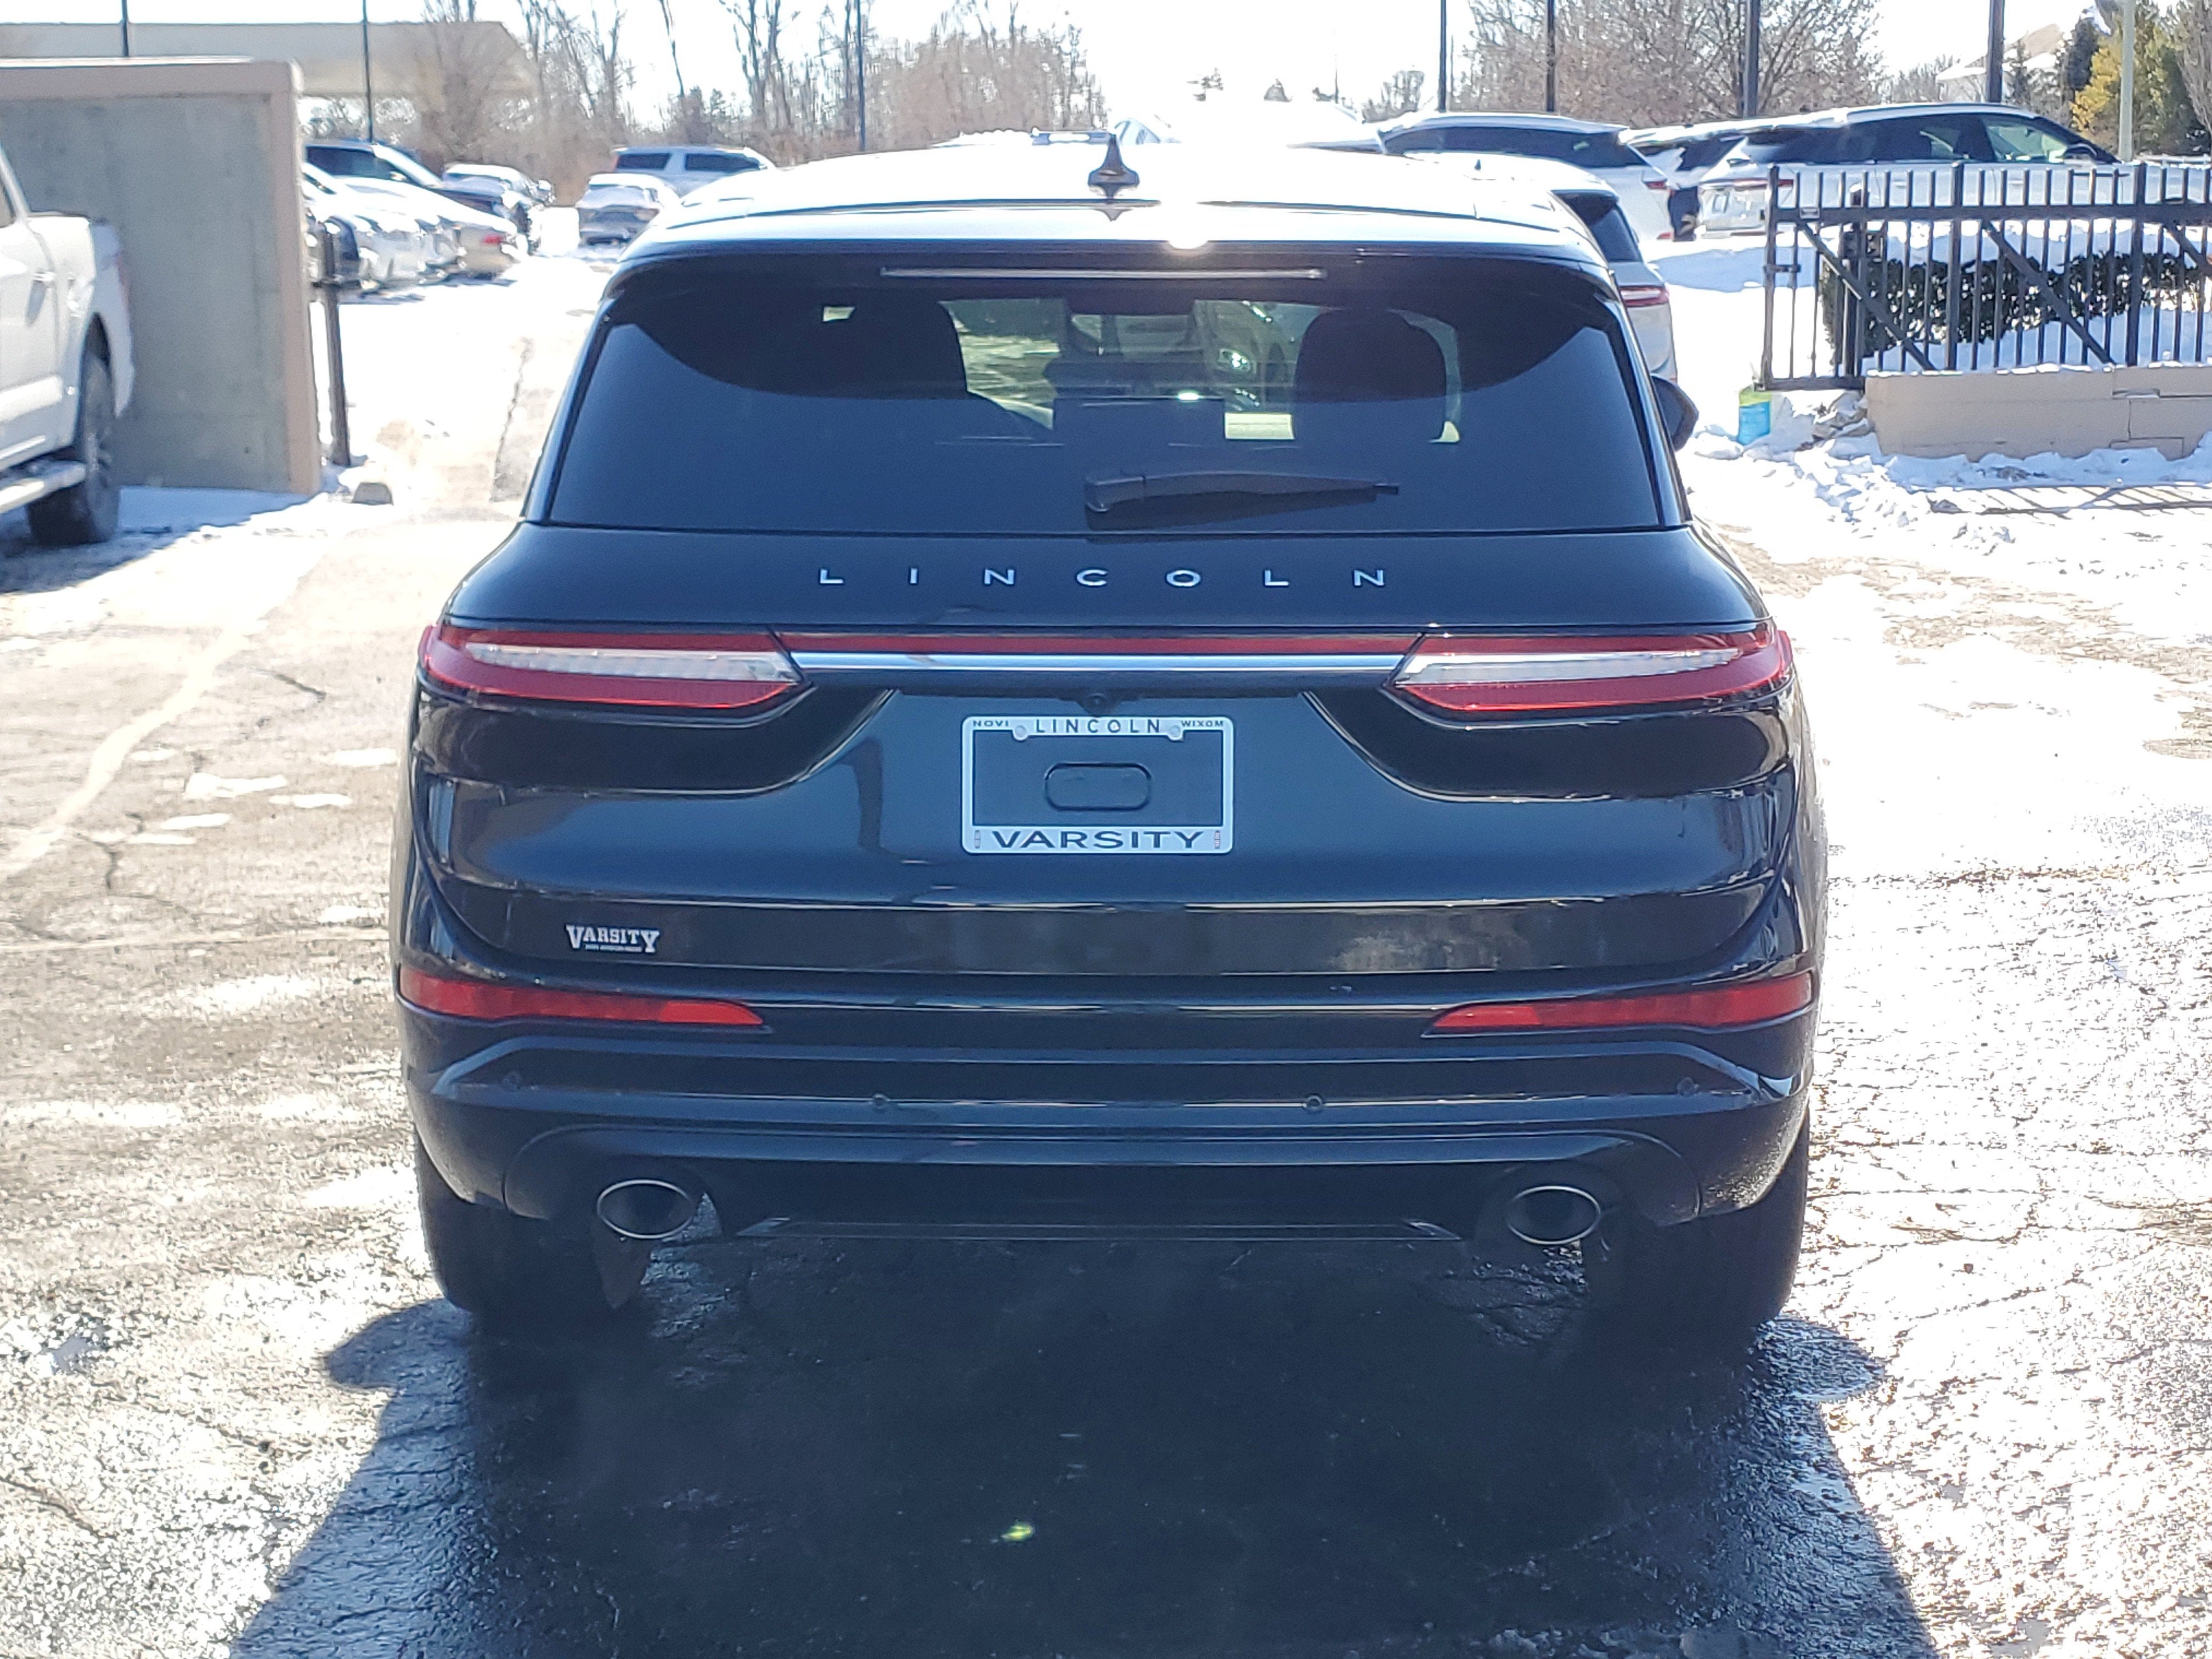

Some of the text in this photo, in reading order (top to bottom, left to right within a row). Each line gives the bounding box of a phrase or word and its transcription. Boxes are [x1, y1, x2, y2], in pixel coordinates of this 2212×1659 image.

[820, 568, 1385, 587] LINCOLN
[1036, 719, 1160, 733] LINCOLN
[992, 831, 1204, 849] VARSITY
[566, 924, 660, 953] VARSITY
